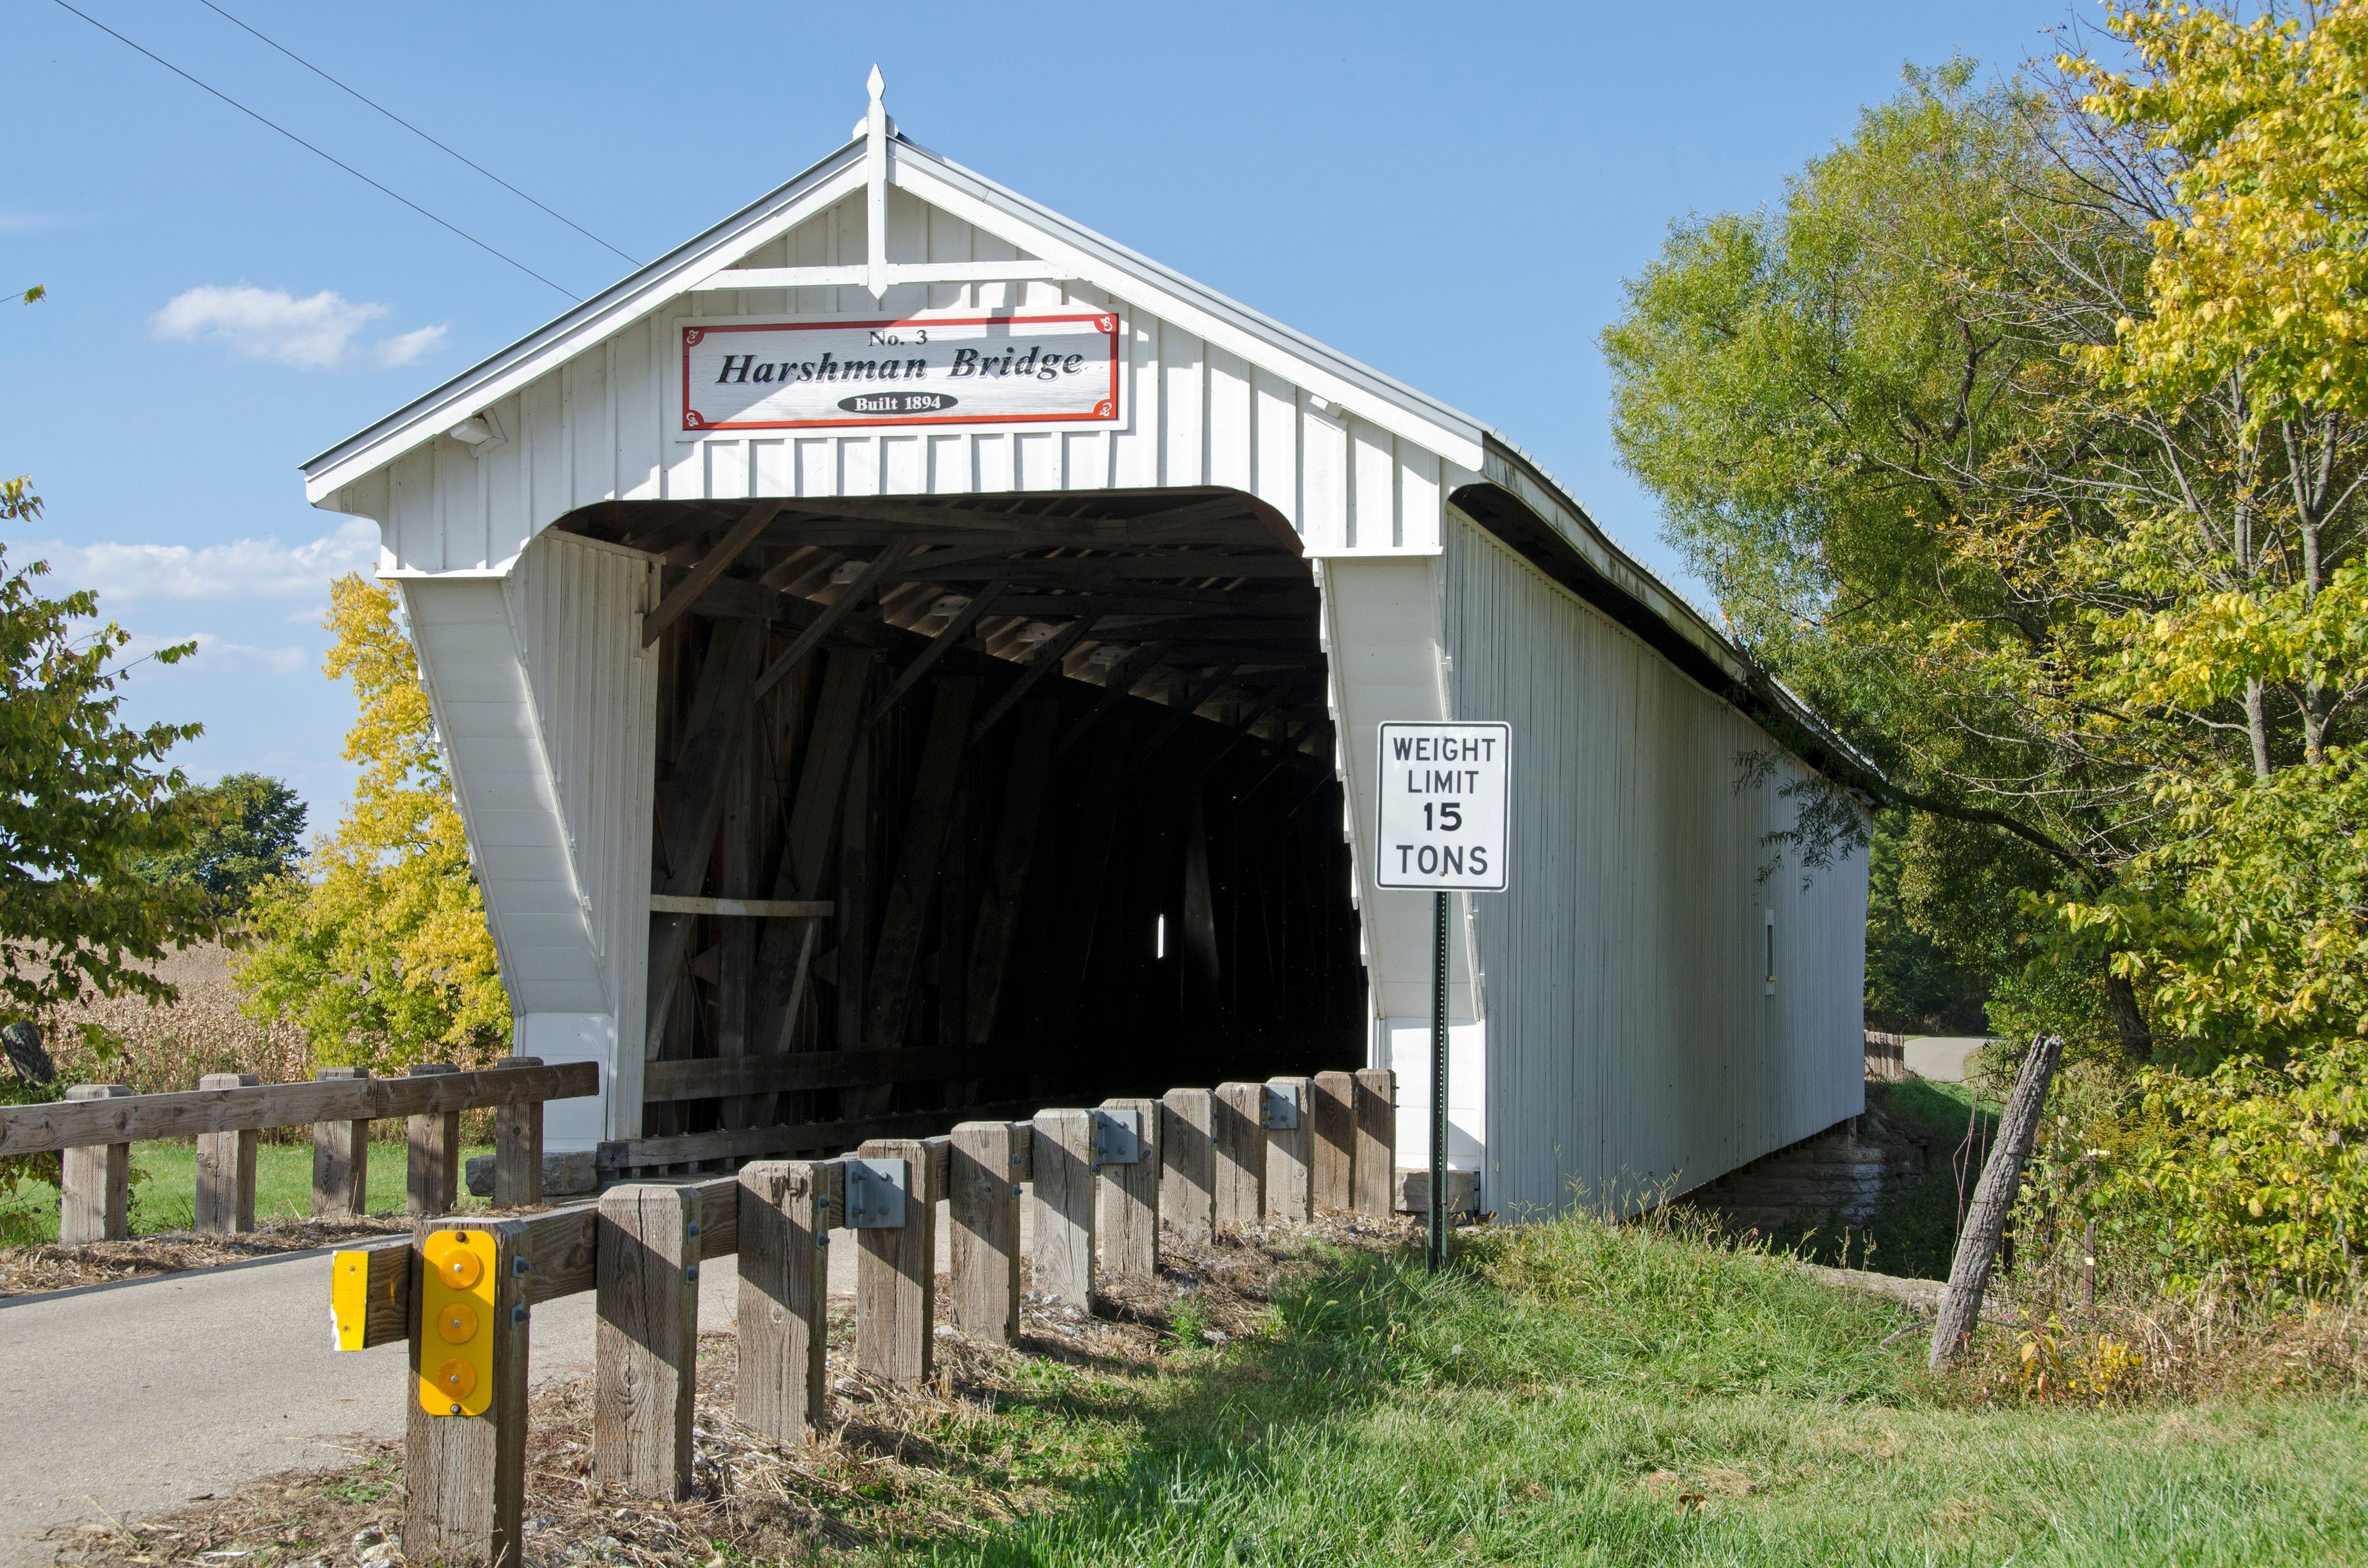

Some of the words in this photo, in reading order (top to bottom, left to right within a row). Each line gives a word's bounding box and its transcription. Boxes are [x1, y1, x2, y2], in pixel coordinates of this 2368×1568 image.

[867, 331, 905, 347] No.
[915, 329, 929, 345] 3
[715, 352, 928, 383] Harshman
[946, 345, 1084, 382] Bridge
[854, 396, 898, 411] Built
[904, 395, 941, 410] 1894
[1393, 737, 1496, 761] WEIGHT
[1408, 770, 1479, 794] LIMIT
[1424, 802, 1462, 832] 15
[1396, 845, 1488, 875] TONS
